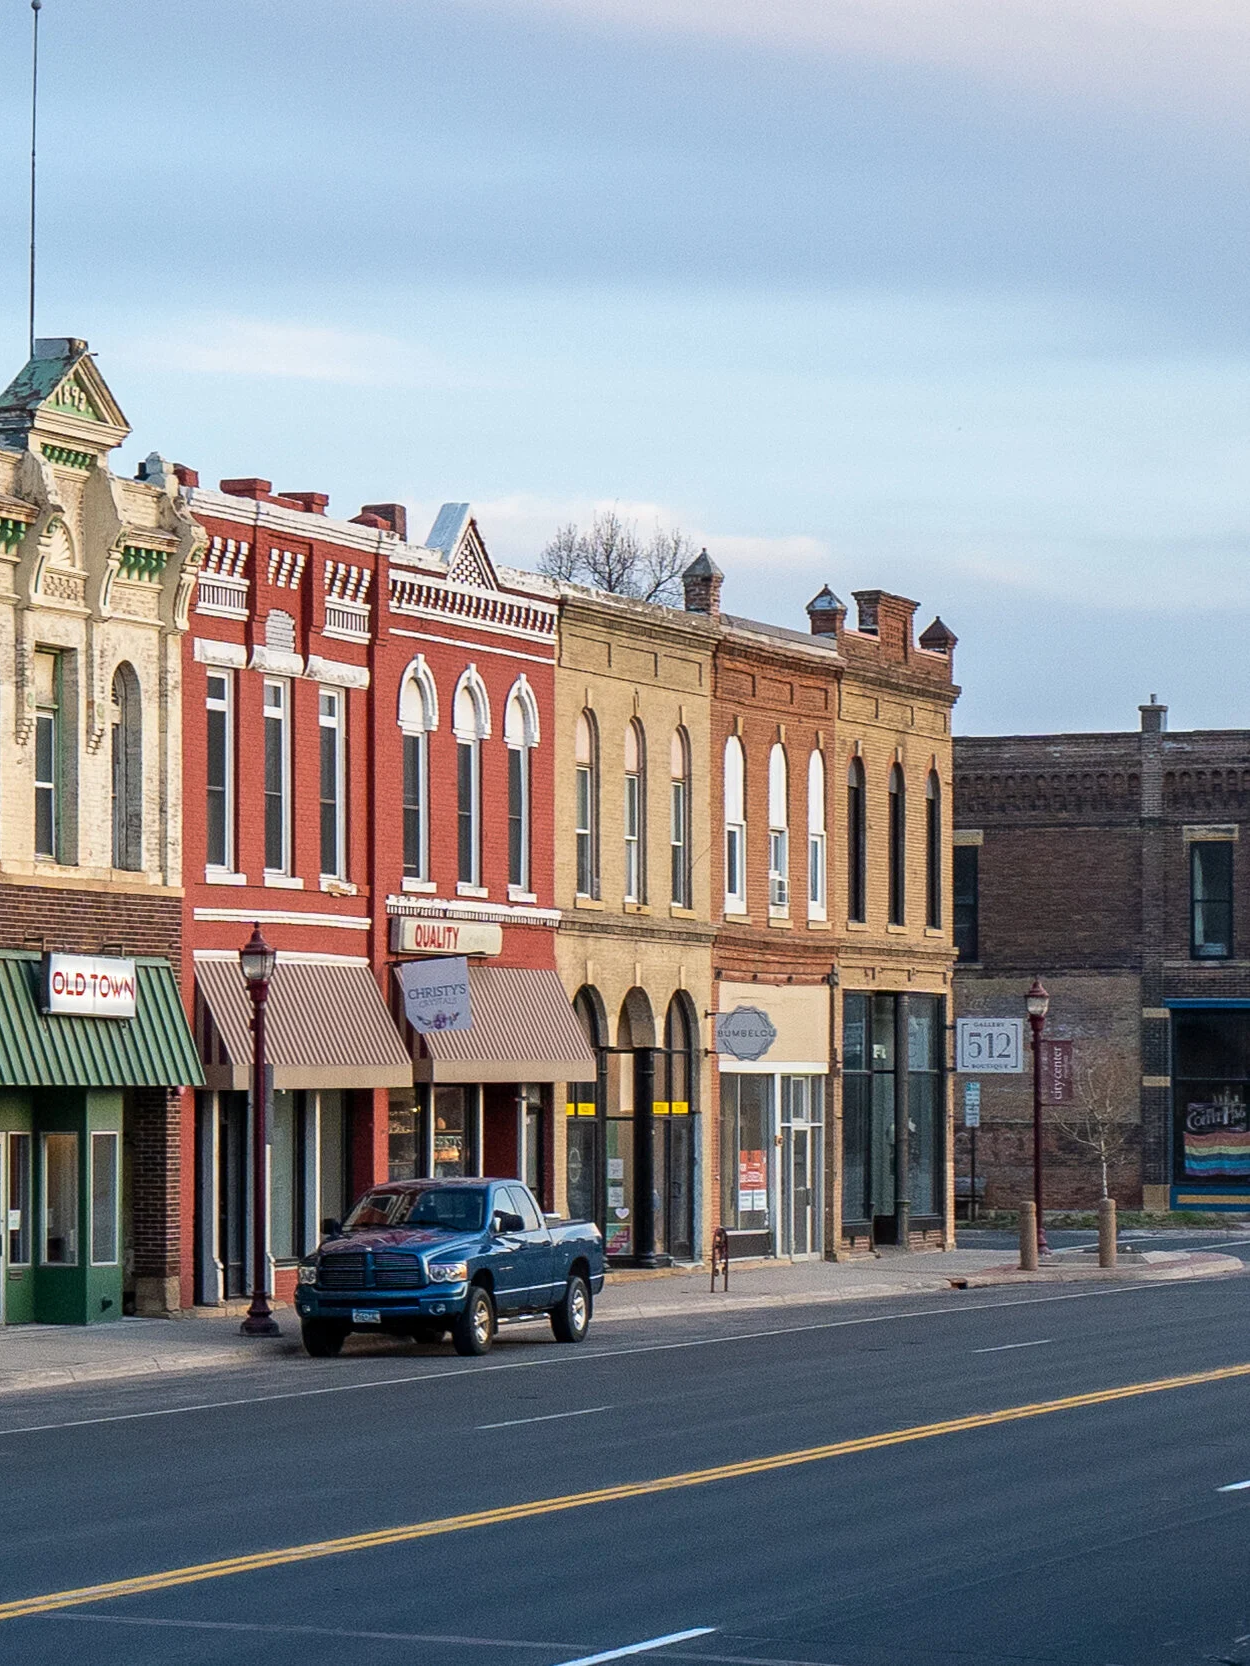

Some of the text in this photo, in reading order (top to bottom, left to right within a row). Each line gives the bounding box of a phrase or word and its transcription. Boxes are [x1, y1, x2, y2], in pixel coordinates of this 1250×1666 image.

[414, 924, 460, 950] QUALITY
[52, 971, 135, 1000] OLD TOWN
[408, 984, 467, 1001] CHRISTY'S
[968, 1032, 1011, 1059] 512
[971, 1063, 1009, 1071] BOUTIQUE
